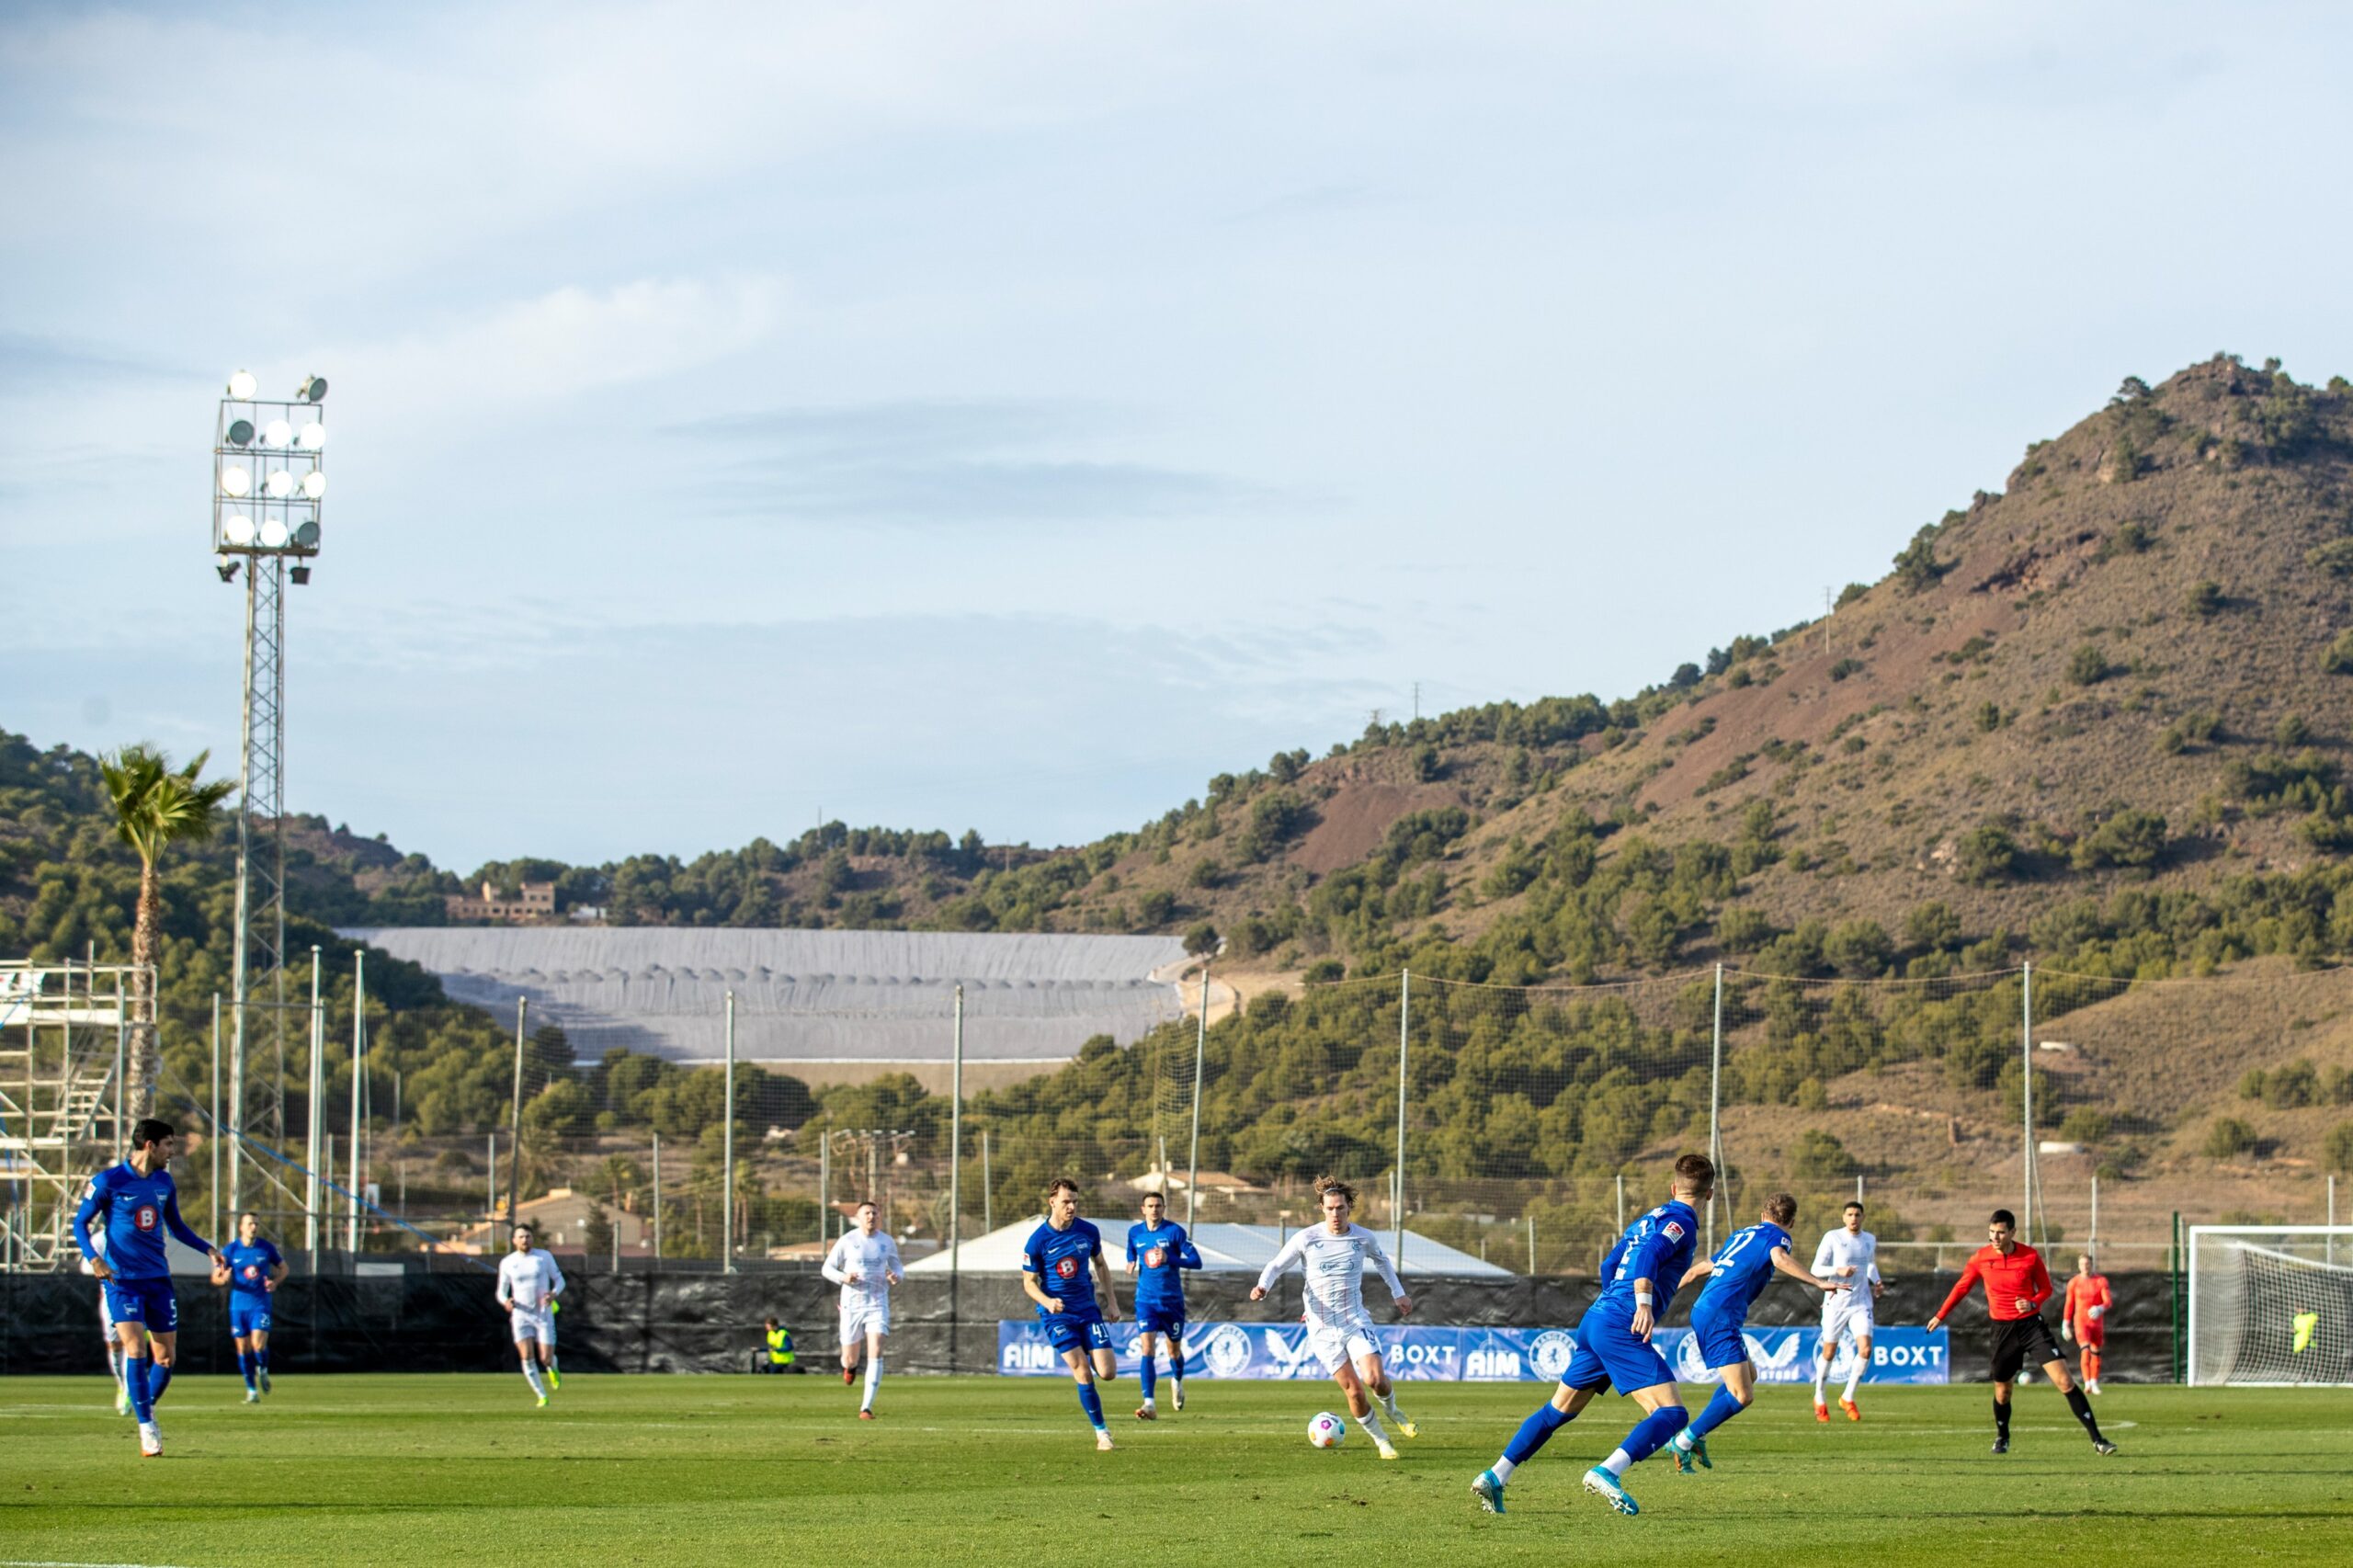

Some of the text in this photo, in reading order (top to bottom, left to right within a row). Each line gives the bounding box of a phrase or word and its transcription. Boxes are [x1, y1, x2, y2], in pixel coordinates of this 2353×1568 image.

[141, 1210, 153, 1227] B
[1060, 1260, 1074, 1274] B
[1091, 1323, 1108, 1338] 41
[1173, 1322, 1180, 1335] 9
[1004, 1343, 1055, 1369] AIM
[1390, 1344, 1456, 1365] BOXT
[1873, 1346, 1943, 1366] BOXT
[1466, 1351, 1520, 1377] AIM
